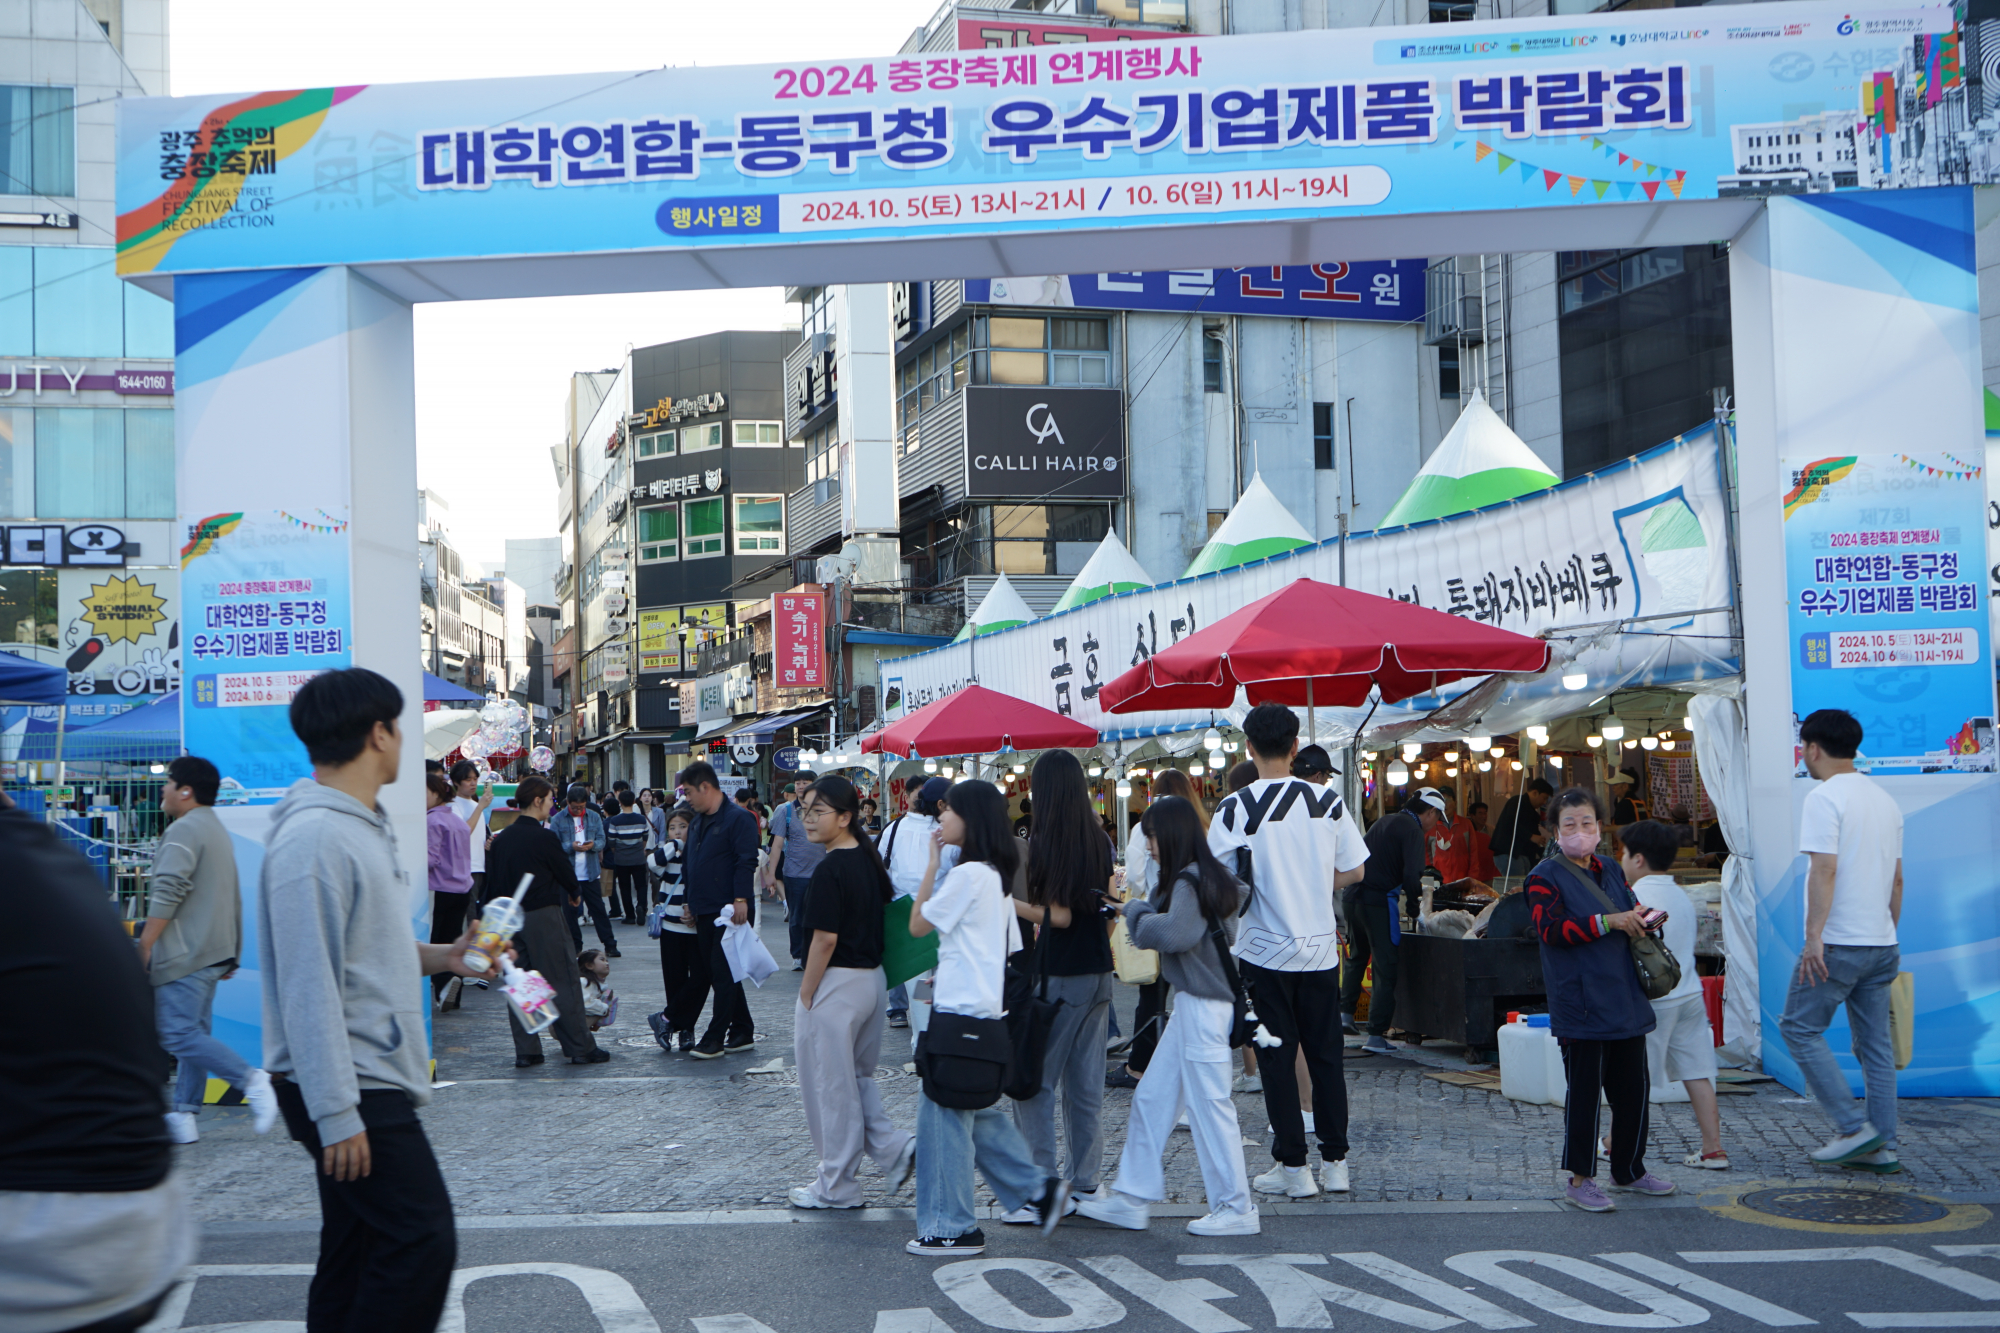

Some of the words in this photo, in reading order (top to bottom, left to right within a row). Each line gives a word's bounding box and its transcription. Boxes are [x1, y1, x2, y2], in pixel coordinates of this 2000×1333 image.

[773, 64, 878, 100] 2024
[887, 53, 1038, 92] 충장축제
[1048, 46, 1202, 85] 연계행사
[423, 106, 949, 186] 대학연합-동구청
[988, 81, 1434, 157] 우수기업제품
[1459, 66, 1684, 134] 박람회
[159, 130, 204, 151] 광주
[209, 126, 276, 149] 추억의
[159, 148, 277, 181] 충장축제
[162, 187, 231, 202] CHUNGJANG
[232, 186, 273, 198] STREET
[970, 186, 1087, 215] 13시~21시
[1166, 180, 1223, 206] 6(일)
[1232, 174, 1349, 202] 11시~19시
[162, 201, 243, 216] FESTIVAL
[250, 197, 275, 211] OF
[45, 213, 70, 228] 4층
[162, 215, 275, 232] RECOLLECTION
[671, 205, 762, 228] 행사일정
[118, 375, 166, 389] 1644-0160
[974, 454, 1037, 471] CALLI
[1046, 455, 1099, 471] HAIR
[1104, 459, 1116, 468] 2F
[633, 485, 647, 499] 3F
[649, 474, 701, 499] 베라타투
[1792, 476, 1830, 487] 충장축제
[0, 524, 126, 567] 디오
[1830, 532, 1858, 548] 2024
[1859, 530, 1899, 546] 충장축제
[1901, 528, 1940, 545] 연계행사
[1815, 552, 1959, 584] 대학연합-동구청
[219, 583, 243, 596] 2024
[244, 580, 276, 595] 충장축제
[278, 579, 312, 594] 연계행사
[1800, 586, 1915, 616] 우수기업제품
[1920, 584, 1978, 613] 박람회
[96, 612, 153, 621] STUDIO
[206, 600, 327, 629] 대학연합-동구청
[647, 621, 666, 630] OPEN
[192, 631, 289, 659] 우수기업제품
[294, 629, 343, 655] 박람회
[1806, 638, 1828, 651] 행사
[1913, 632, 1963, 646] 13시~21시
[1807, 651, 1828, 663] 일정
[1914, 648, 1964, 662] 11시~19시
[196, 680, 215, 691] 행사
[196, 691, 215, 702] 일정
[70, 703, 106, 716] 백프로
[736, 746, 755, 756] AS
